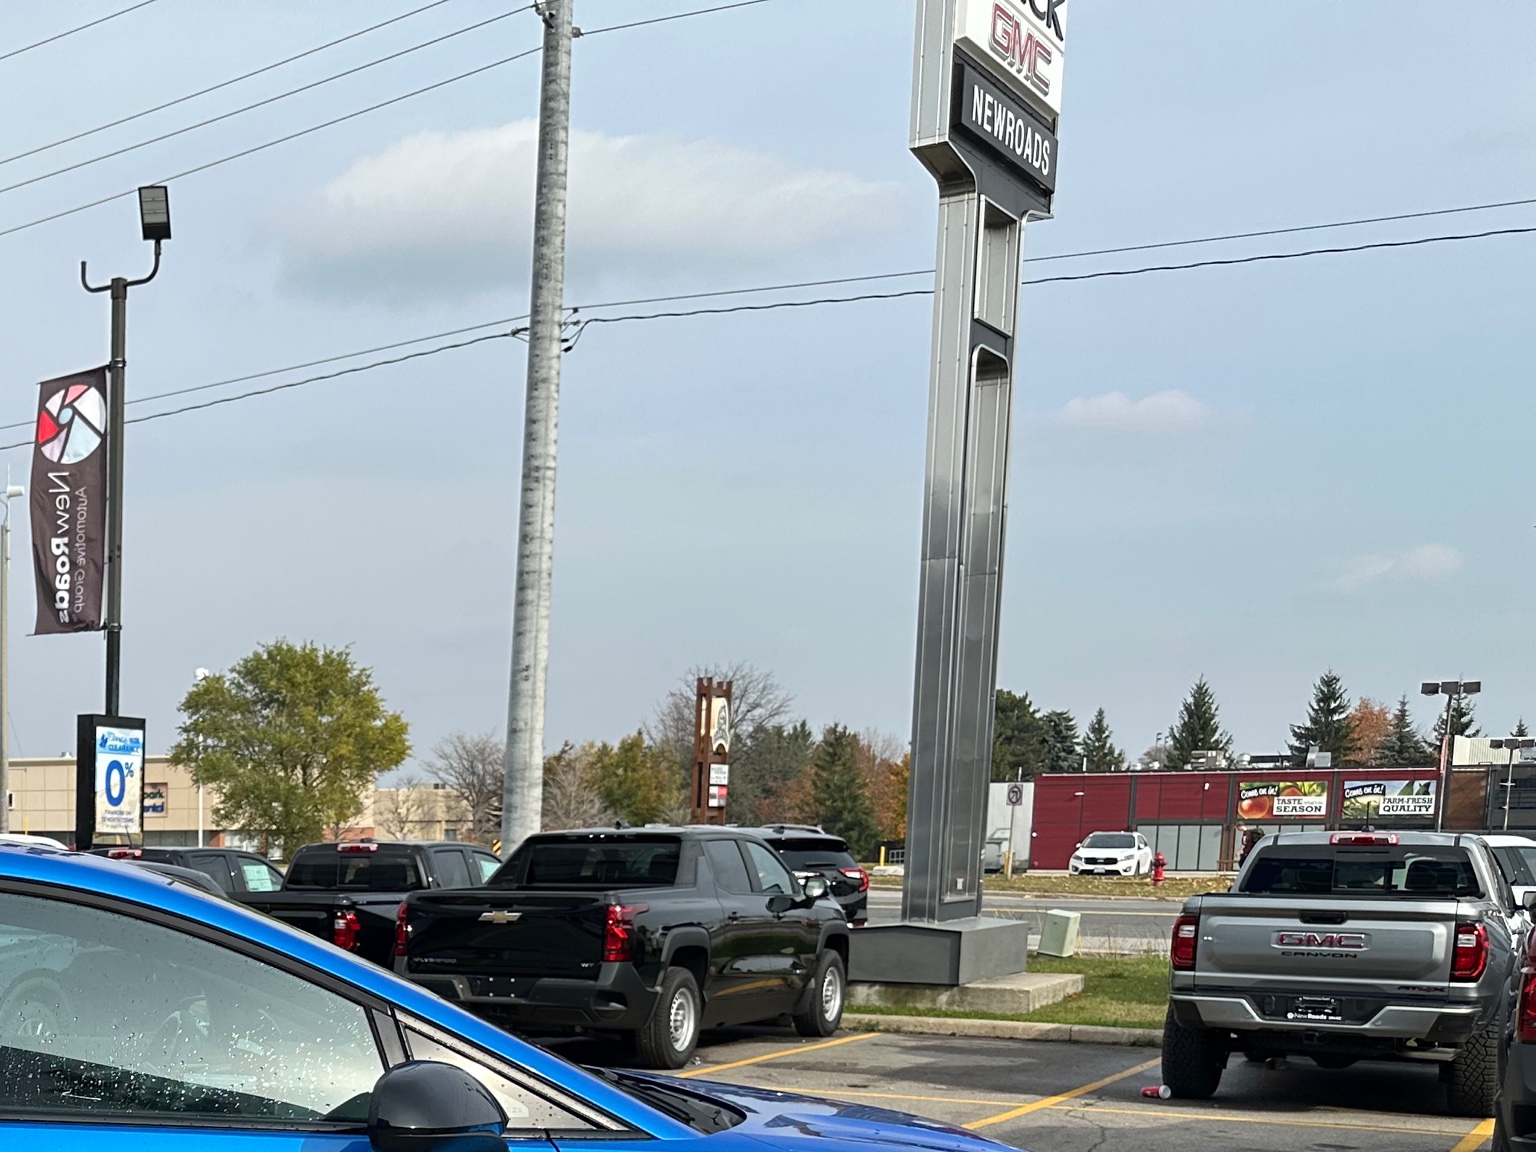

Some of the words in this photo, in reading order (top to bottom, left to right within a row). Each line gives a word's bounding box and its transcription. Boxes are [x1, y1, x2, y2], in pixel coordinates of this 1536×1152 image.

[1021, 0, 1064, 42] CK
[988, 0, 1052, 97] GMC
[971, 84, 1050, 176] NEWROADS
[1259, 787, 1267, 796] on
[1364, 785, 1372, 794] on
[1276, 805, 1322, 813] SEASON
[1382, 805, 1432, 813] QUALITY
[1279, 932, 1366, 948] GMC
[1281, 951, 1357, 959] CANYON
